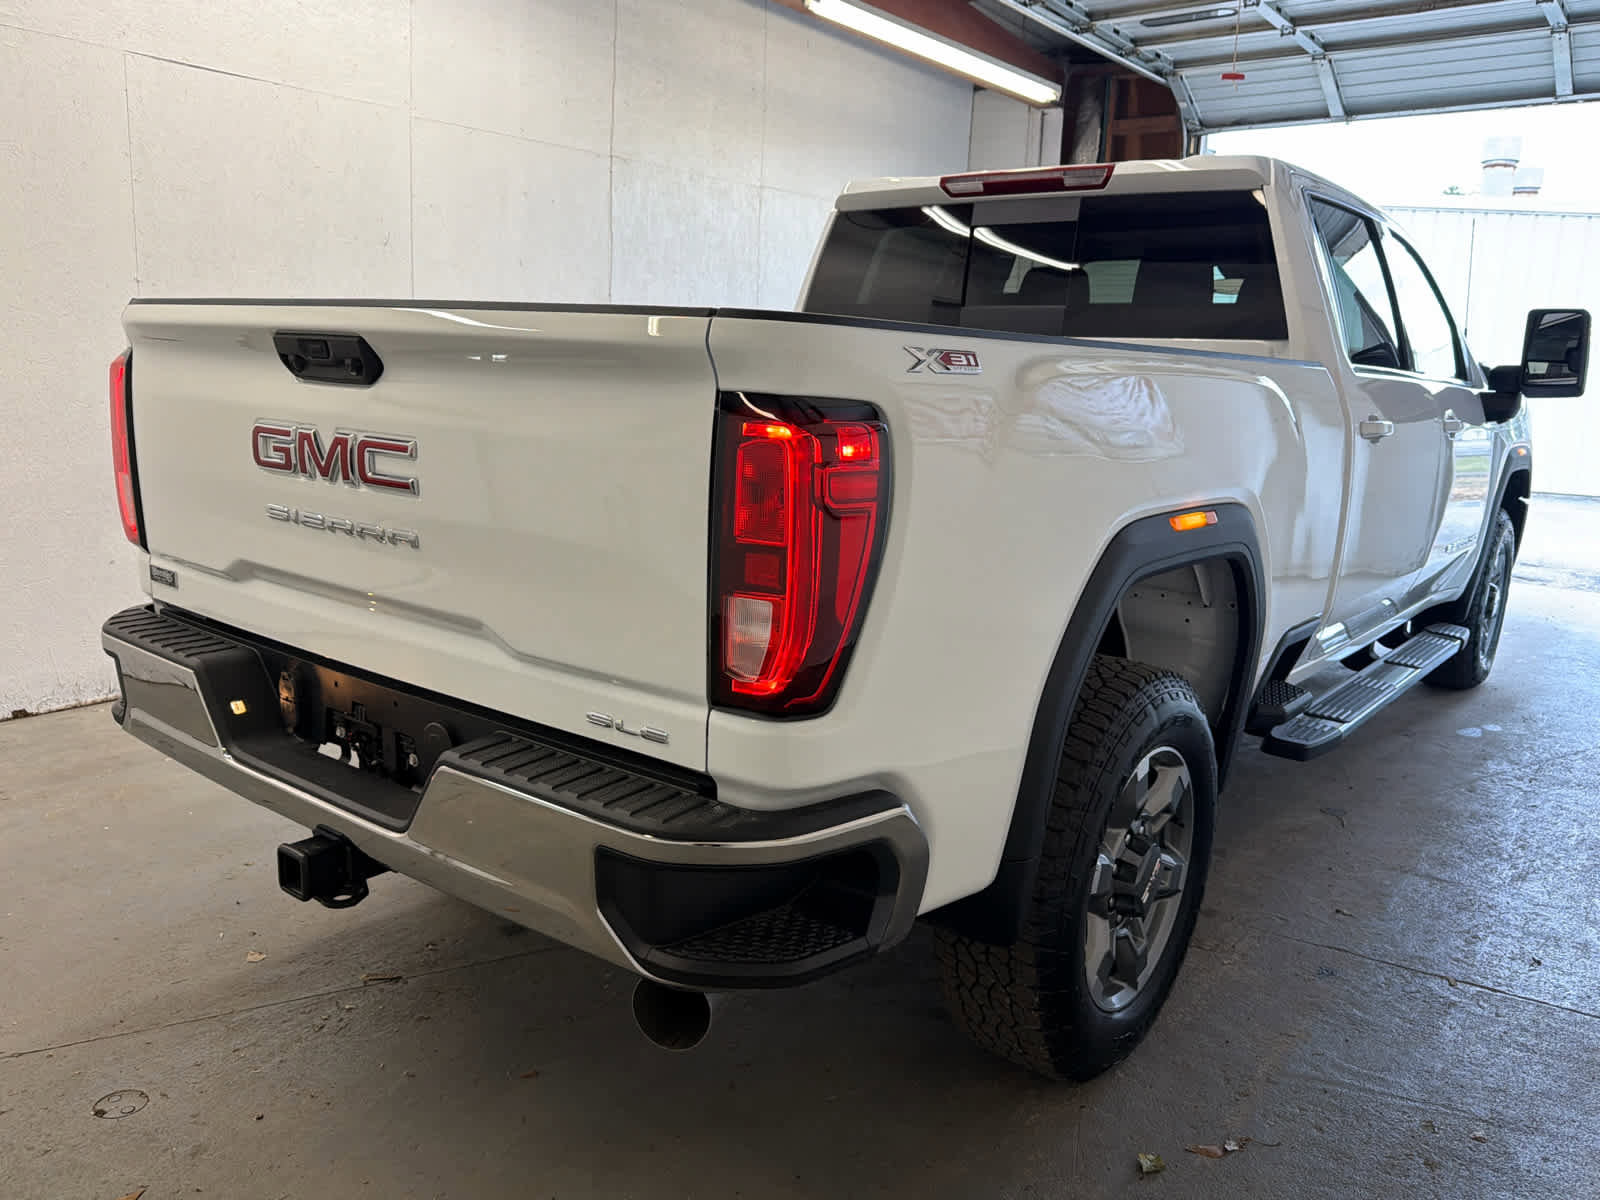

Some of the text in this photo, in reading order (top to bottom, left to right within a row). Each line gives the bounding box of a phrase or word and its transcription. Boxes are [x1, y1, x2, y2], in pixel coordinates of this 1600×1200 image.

[903, 346, 982, 375] X31
[252, 419, 420, 496] GMC
[265, 503, 420, 548] SIERRA
